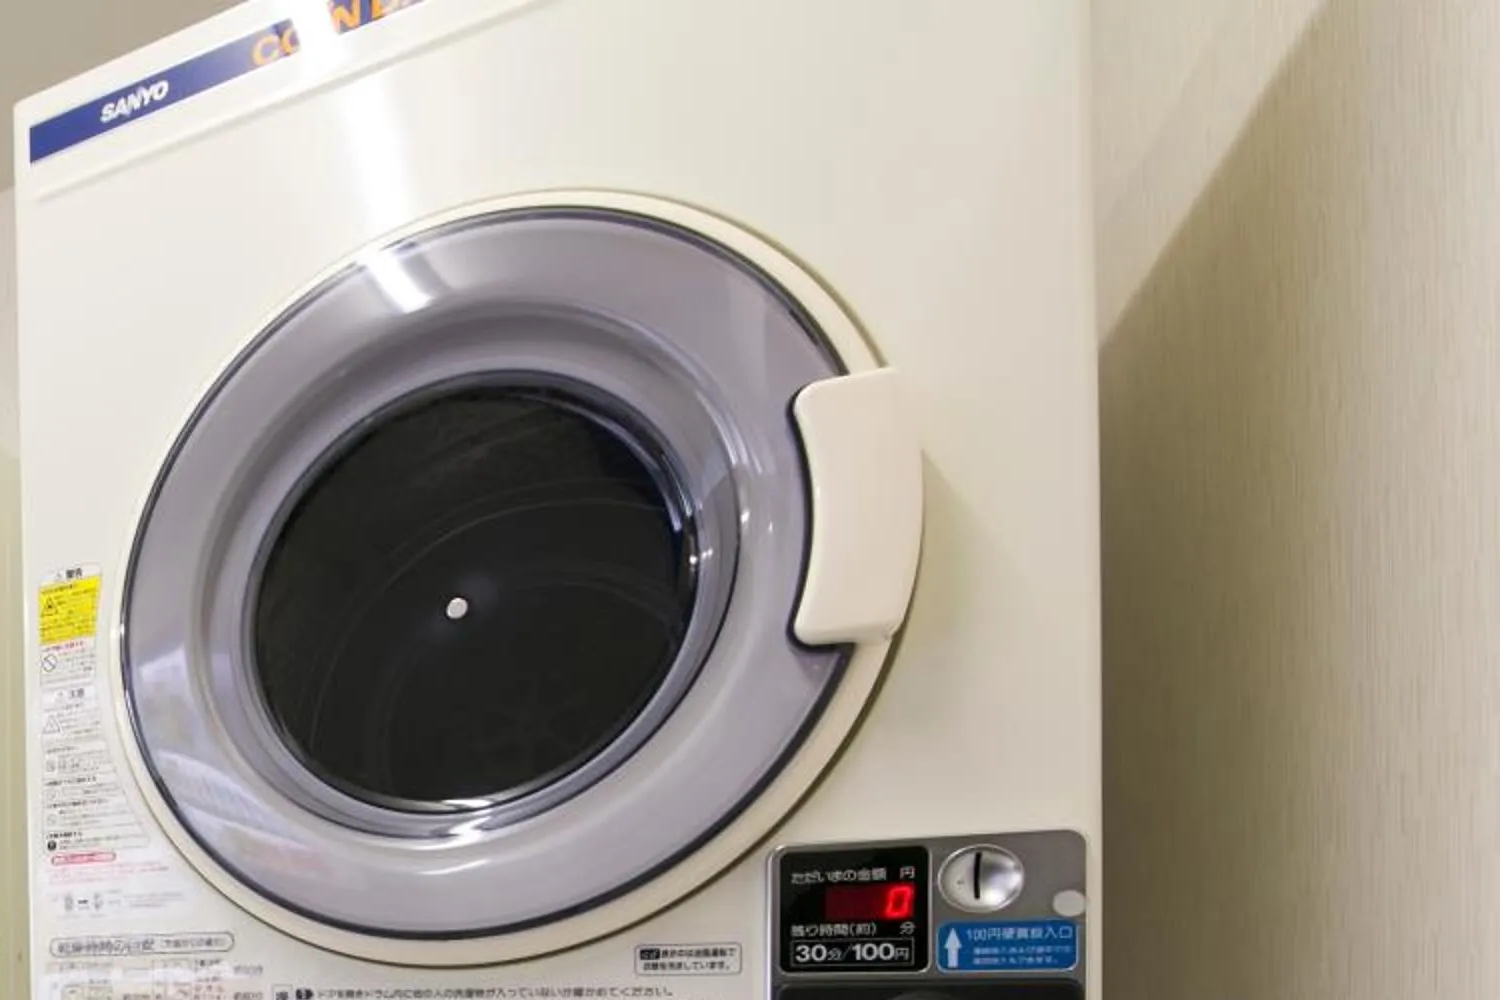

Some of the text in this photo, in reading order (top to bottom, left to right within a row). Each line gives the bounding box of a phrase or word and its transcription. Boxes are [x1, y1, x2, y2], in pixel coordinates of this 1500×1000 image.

[100, 79, 169, 124] SANYO
[900, 866, 916, 880] 円
[886, 885, 915, 919] 0
[900, 921, 916, 936] 分
